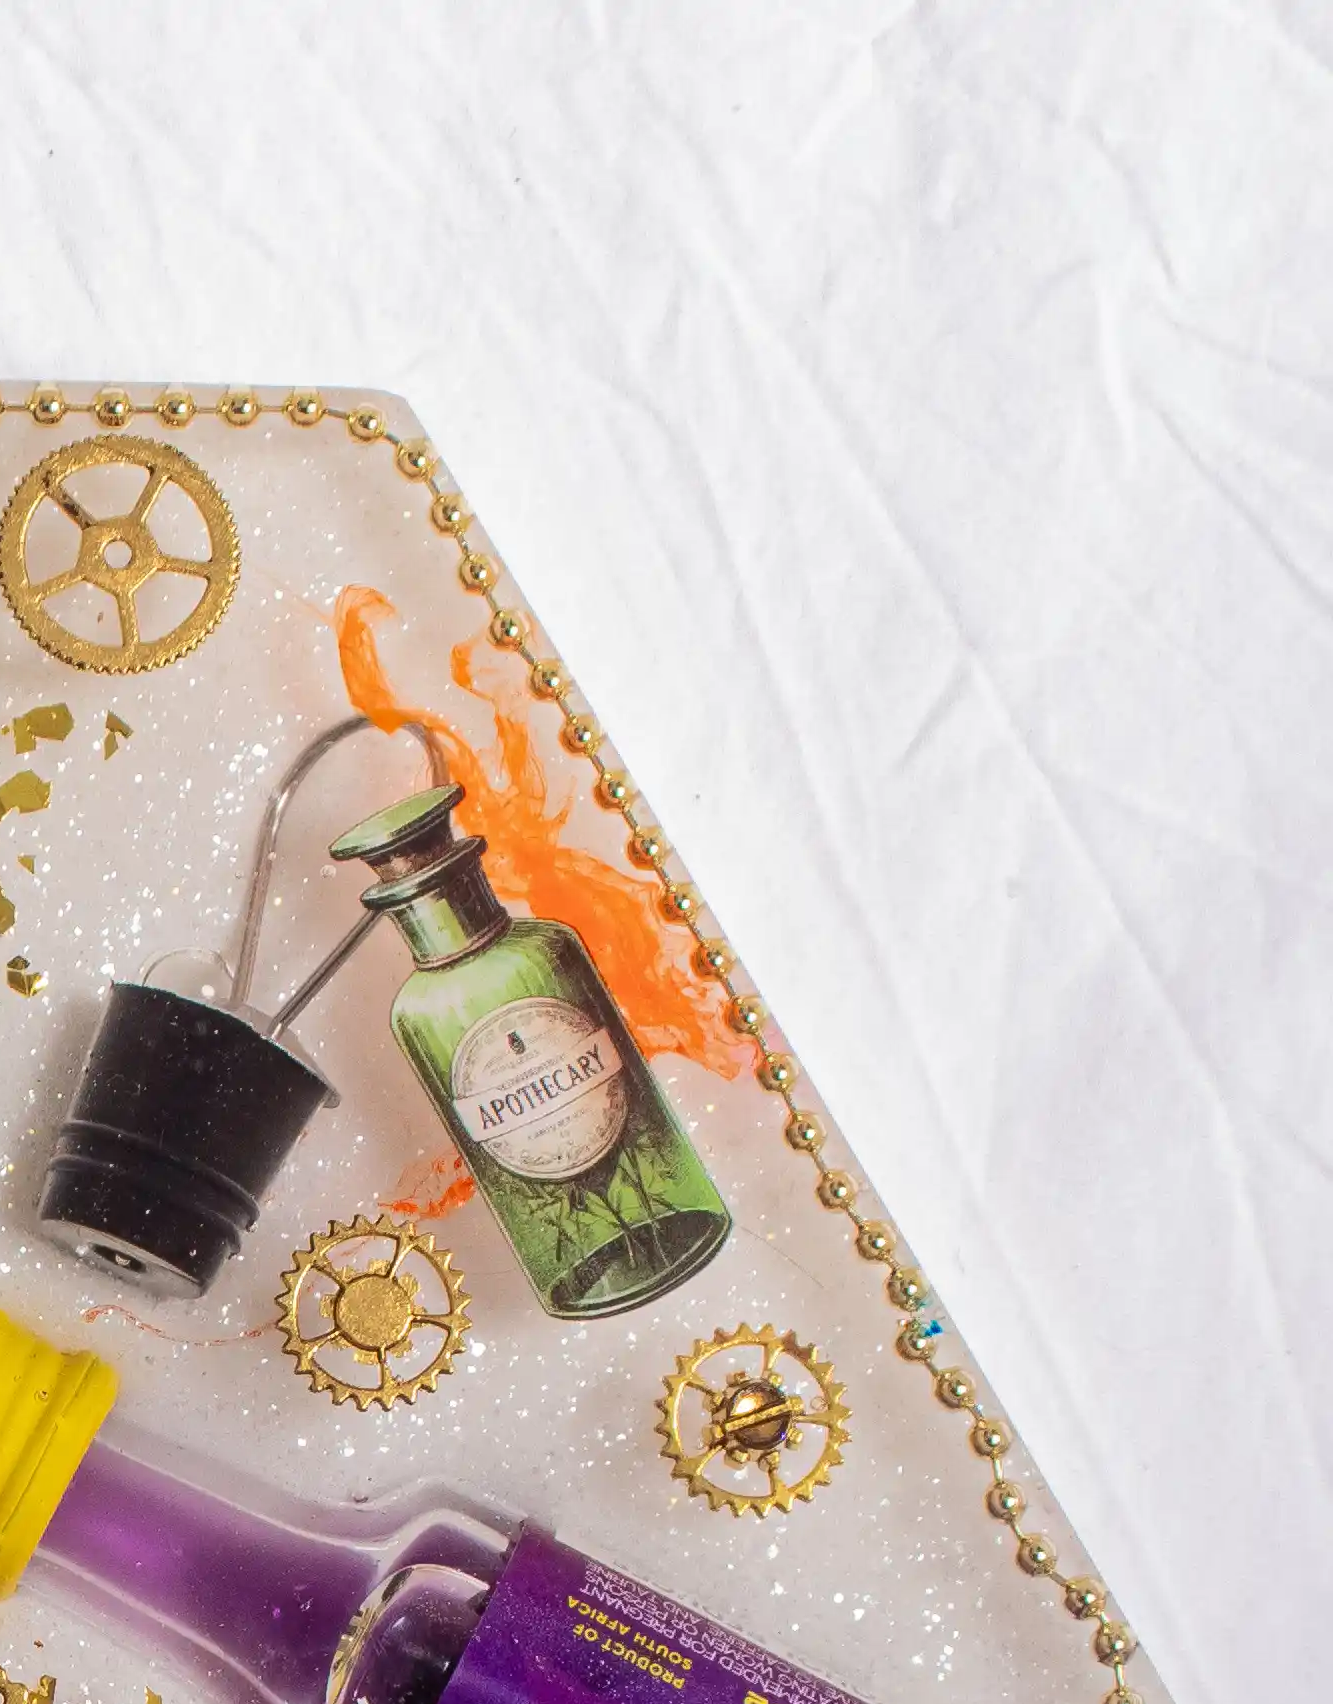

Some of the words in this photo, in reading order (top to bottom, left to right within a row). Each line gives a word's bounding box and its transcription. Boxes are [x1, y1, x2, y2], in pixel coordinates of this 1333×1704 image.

[564, 1594, 631, 1636] AFRICA
[579, 1580, 677, 1638] PREGNANT
[582, 1569, 669, 1621] PERSONS
[572, 1620, 600, 1643] OF
[670, 1615, 699, 1637] OR
[677, 1632, 717, 1661] FOR
[599, 1634, 686, 1690] PRODUCT
[632, 1630, 694, 1670] SOUTH
[700, 1631, 775, 1678] WOMEN
